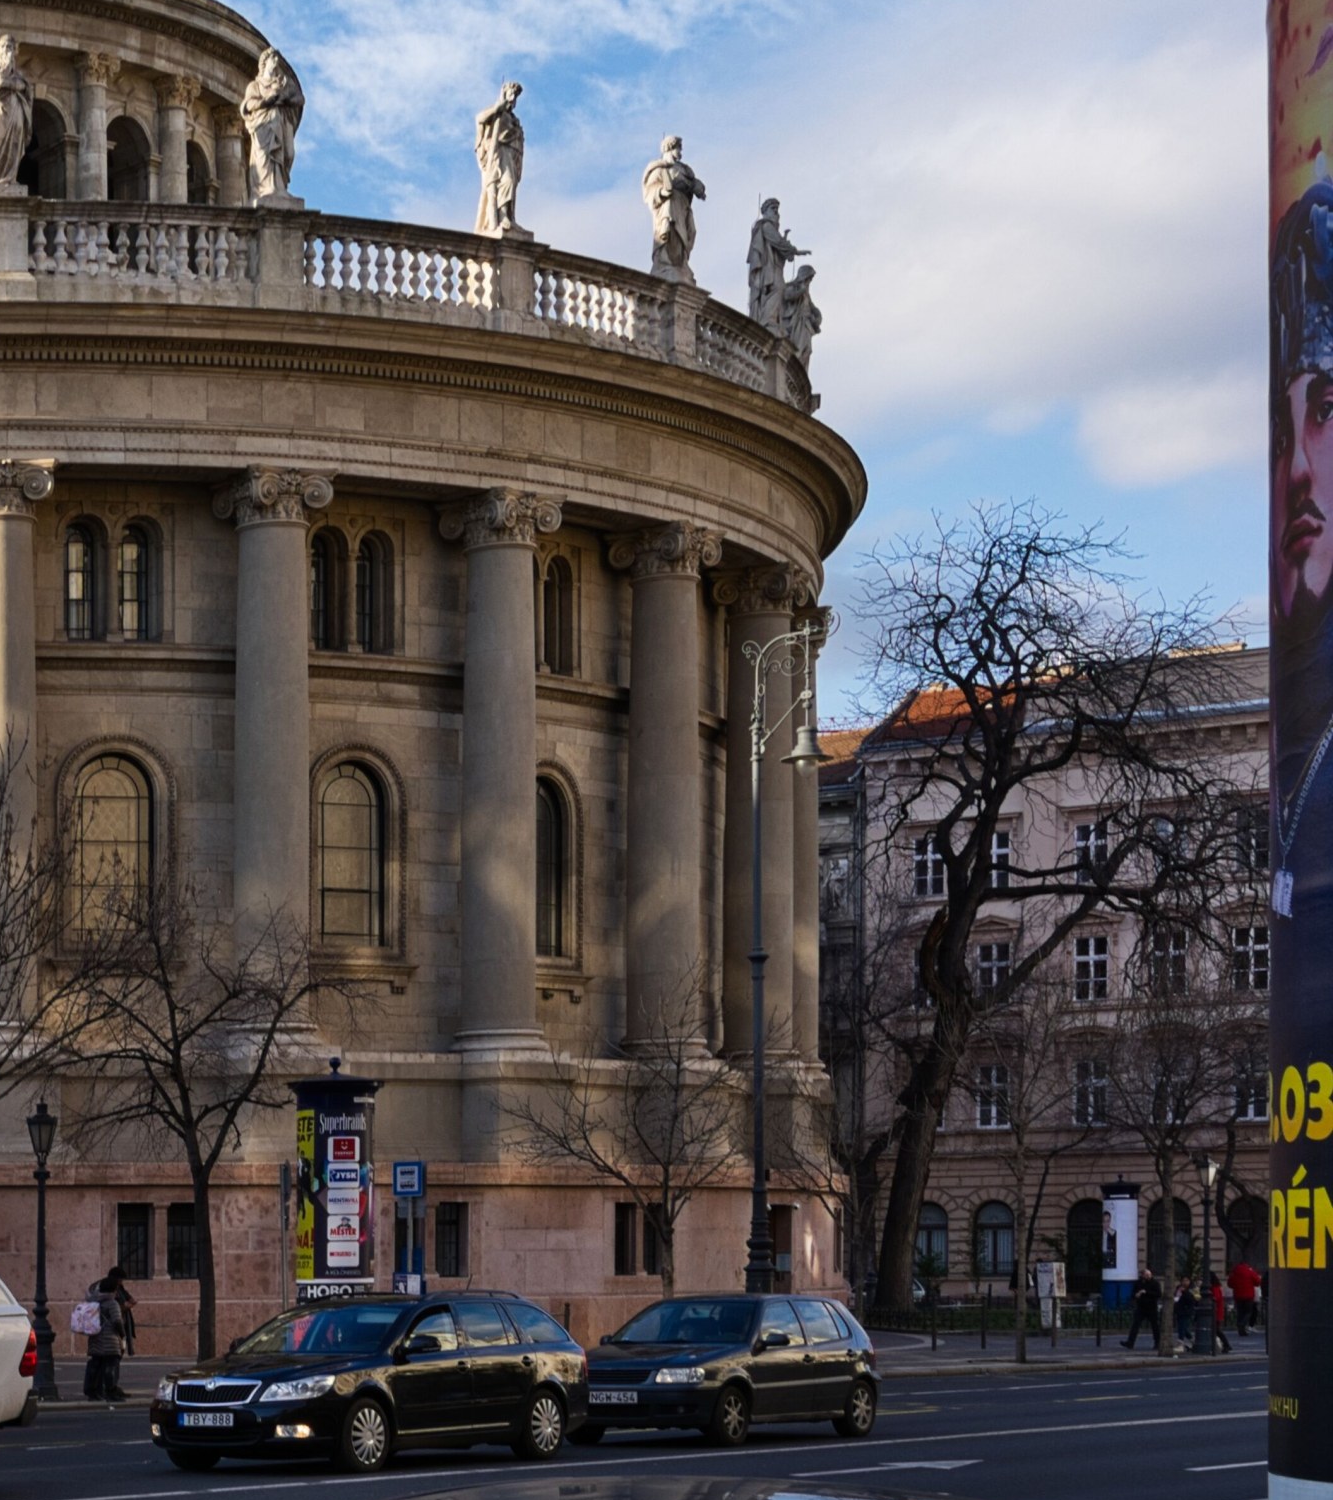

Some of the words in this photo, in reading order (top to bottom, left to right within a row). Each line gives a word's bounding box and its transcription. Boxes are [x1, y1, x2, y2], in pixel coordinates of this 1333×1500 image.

[335, 1171, 357, 1180] JYSK
[330, 1228, 356, 1236] MESTER
[186, 1414, 231, 1425] TBY-888
